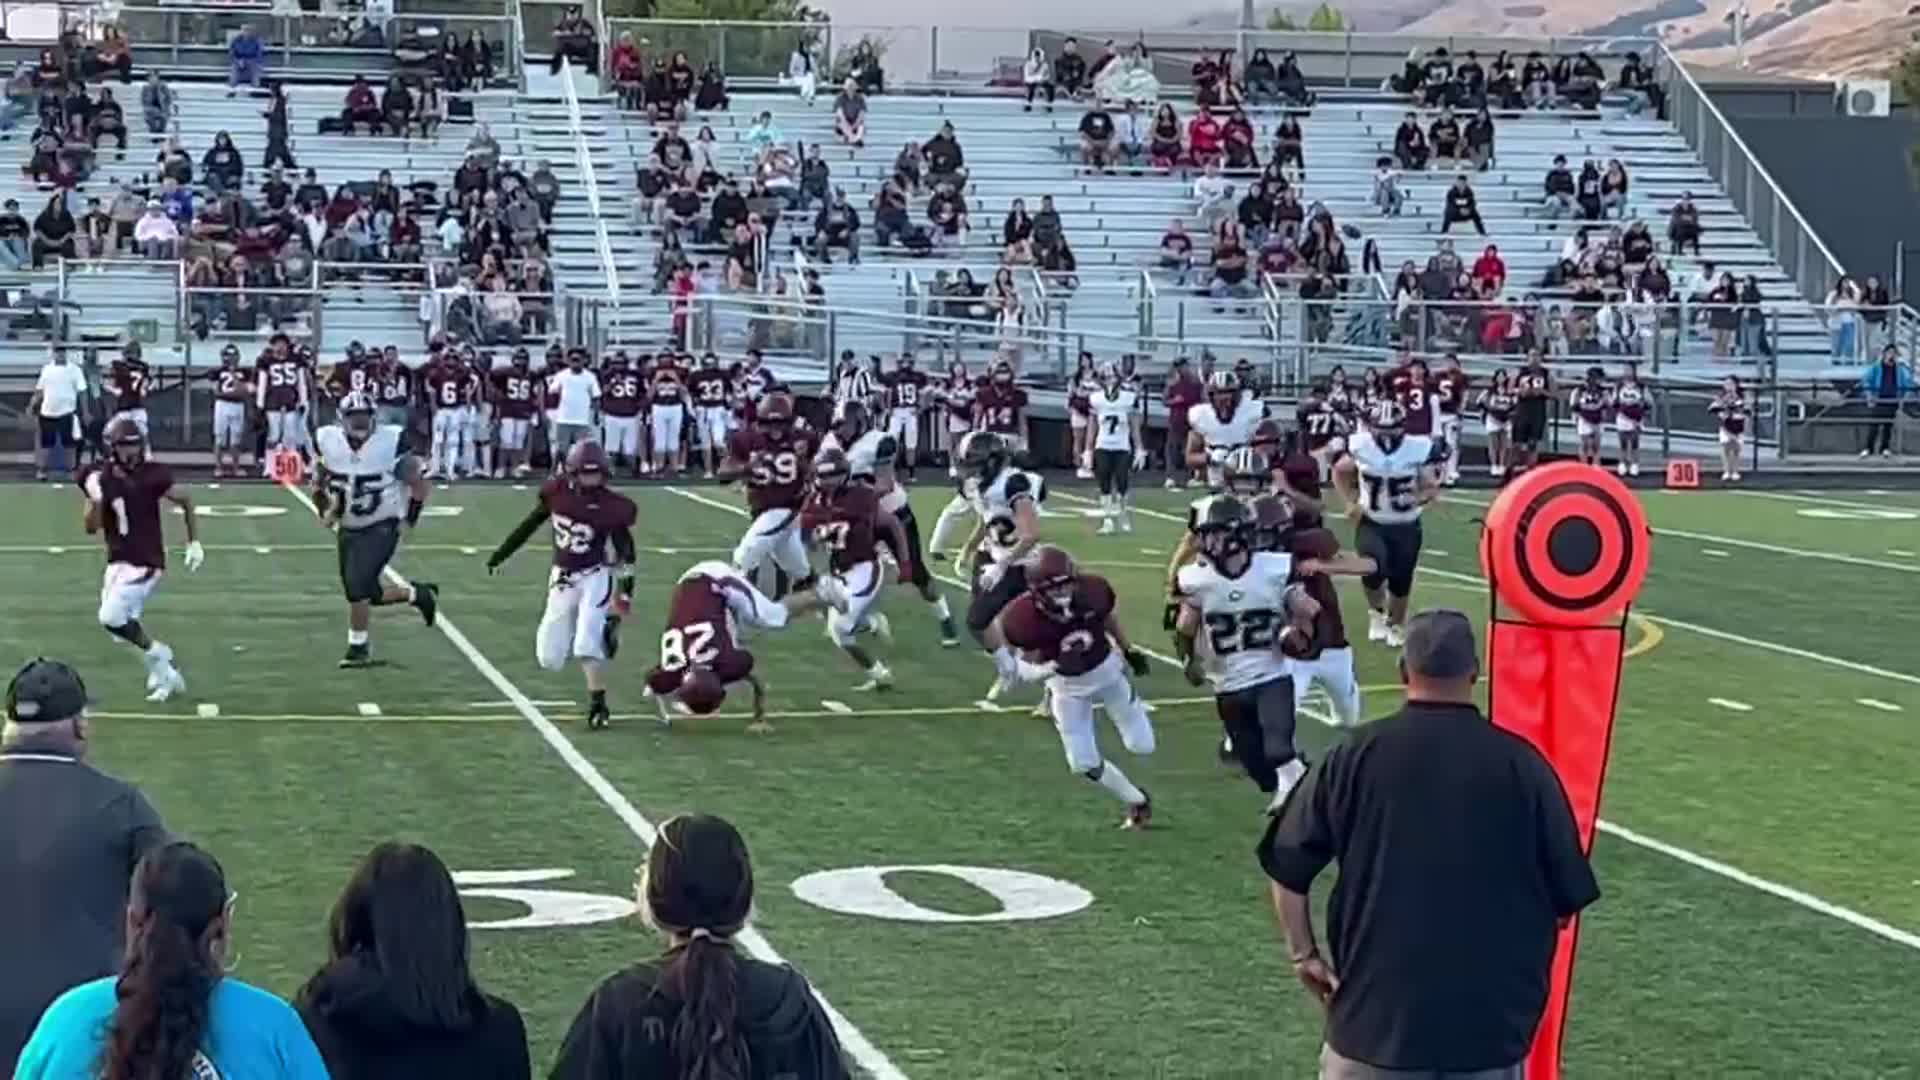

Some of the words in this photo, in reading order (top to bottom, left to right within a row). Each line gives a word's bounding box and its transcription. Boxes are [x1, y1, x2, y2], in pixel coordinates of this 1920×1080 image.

[270, 362, 297, 386] 55
[441, 381, 456, 404] 6
[1409, 388, 1424, 410] 3
[1439, 380, 1453, 401] 5
[1104, 415, 1120, 435] 7
[274, 454, 299, 477] 50
[1672, 463, 1695, 484] 30
[1361, 474, 1415, 513] 75
[112, 496, 129, 536] 1
[1205, 609, 1281, 656] 22
